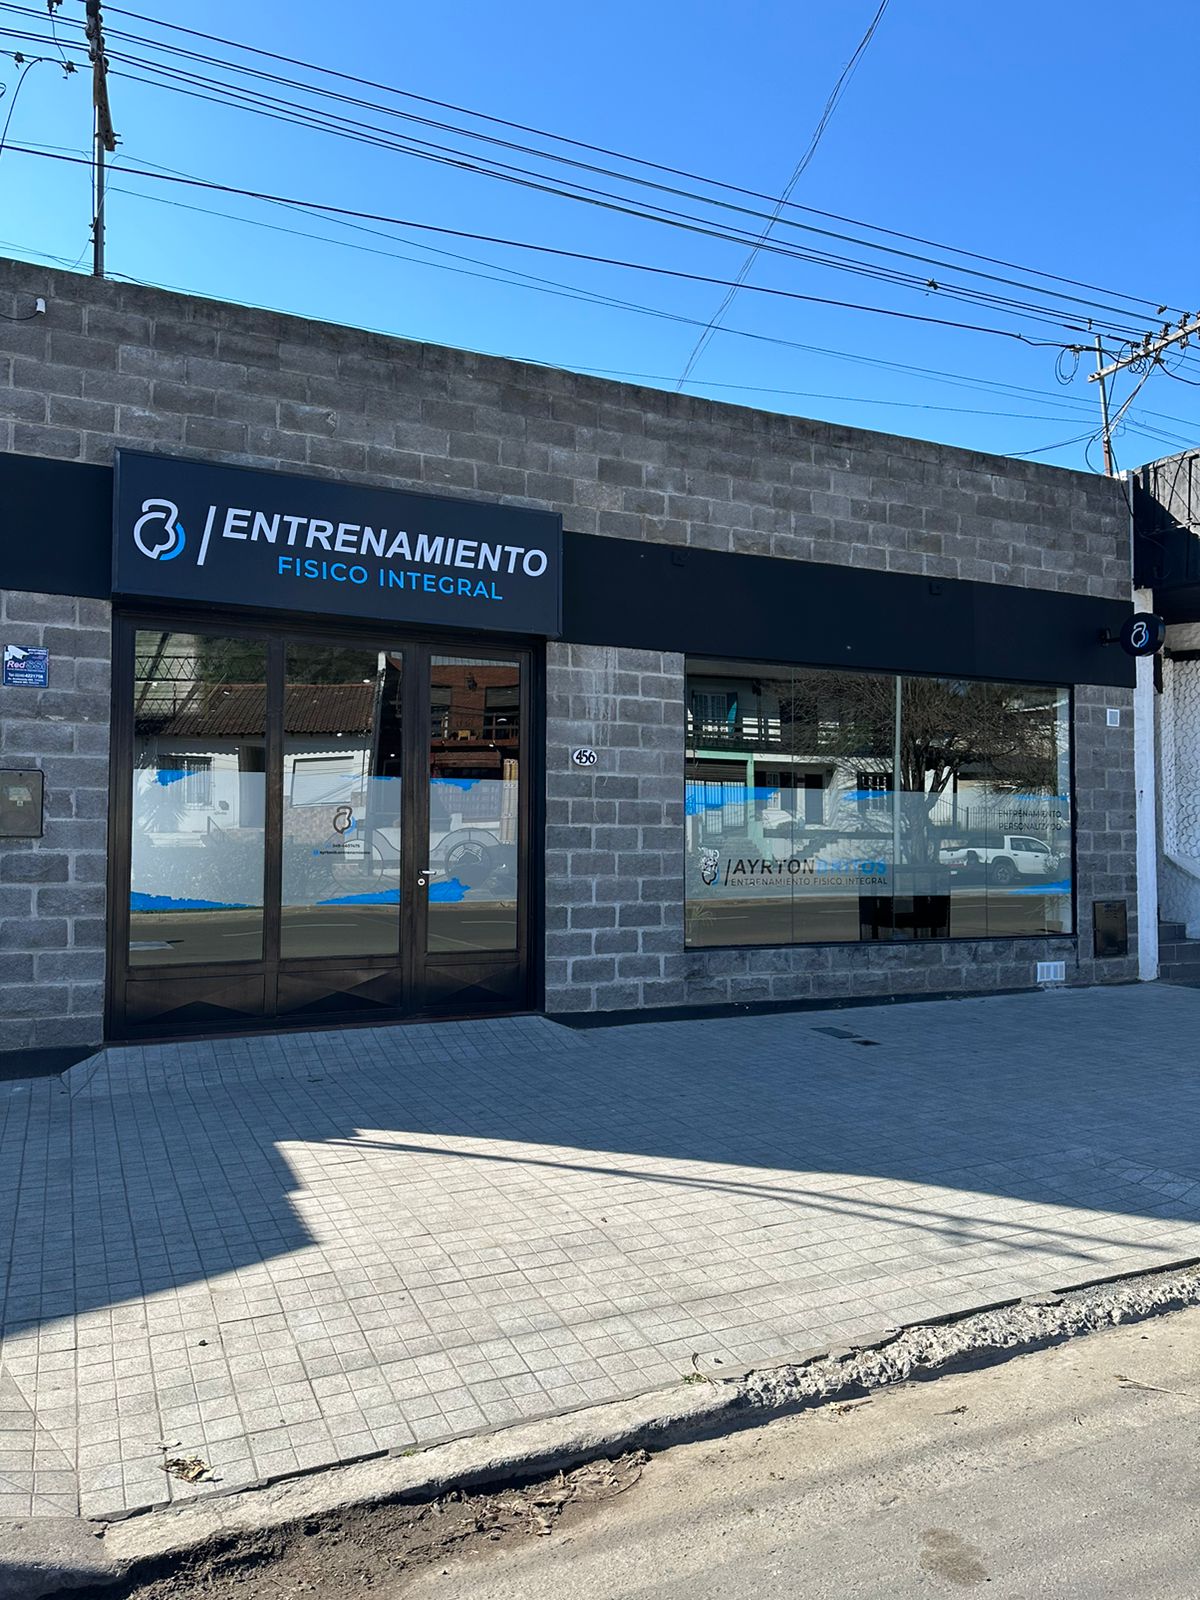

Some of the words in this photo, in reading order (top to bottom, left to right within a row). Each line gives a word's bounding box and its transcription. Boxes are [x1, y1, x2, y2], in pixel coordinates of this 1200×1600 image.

[222, 508, 548, 577] ENTRENAMIENTO
[277, 556, 369, 585] FISICO
[379, 568, 504, 600] INTEGRAL
[576, 750, 596, 764] 456
[730, 877, 810, 887] ENTRENAMIENTO
[813, 877, 842, 886] FISICO
[844, 877, 888, 886] INTEGRAL
